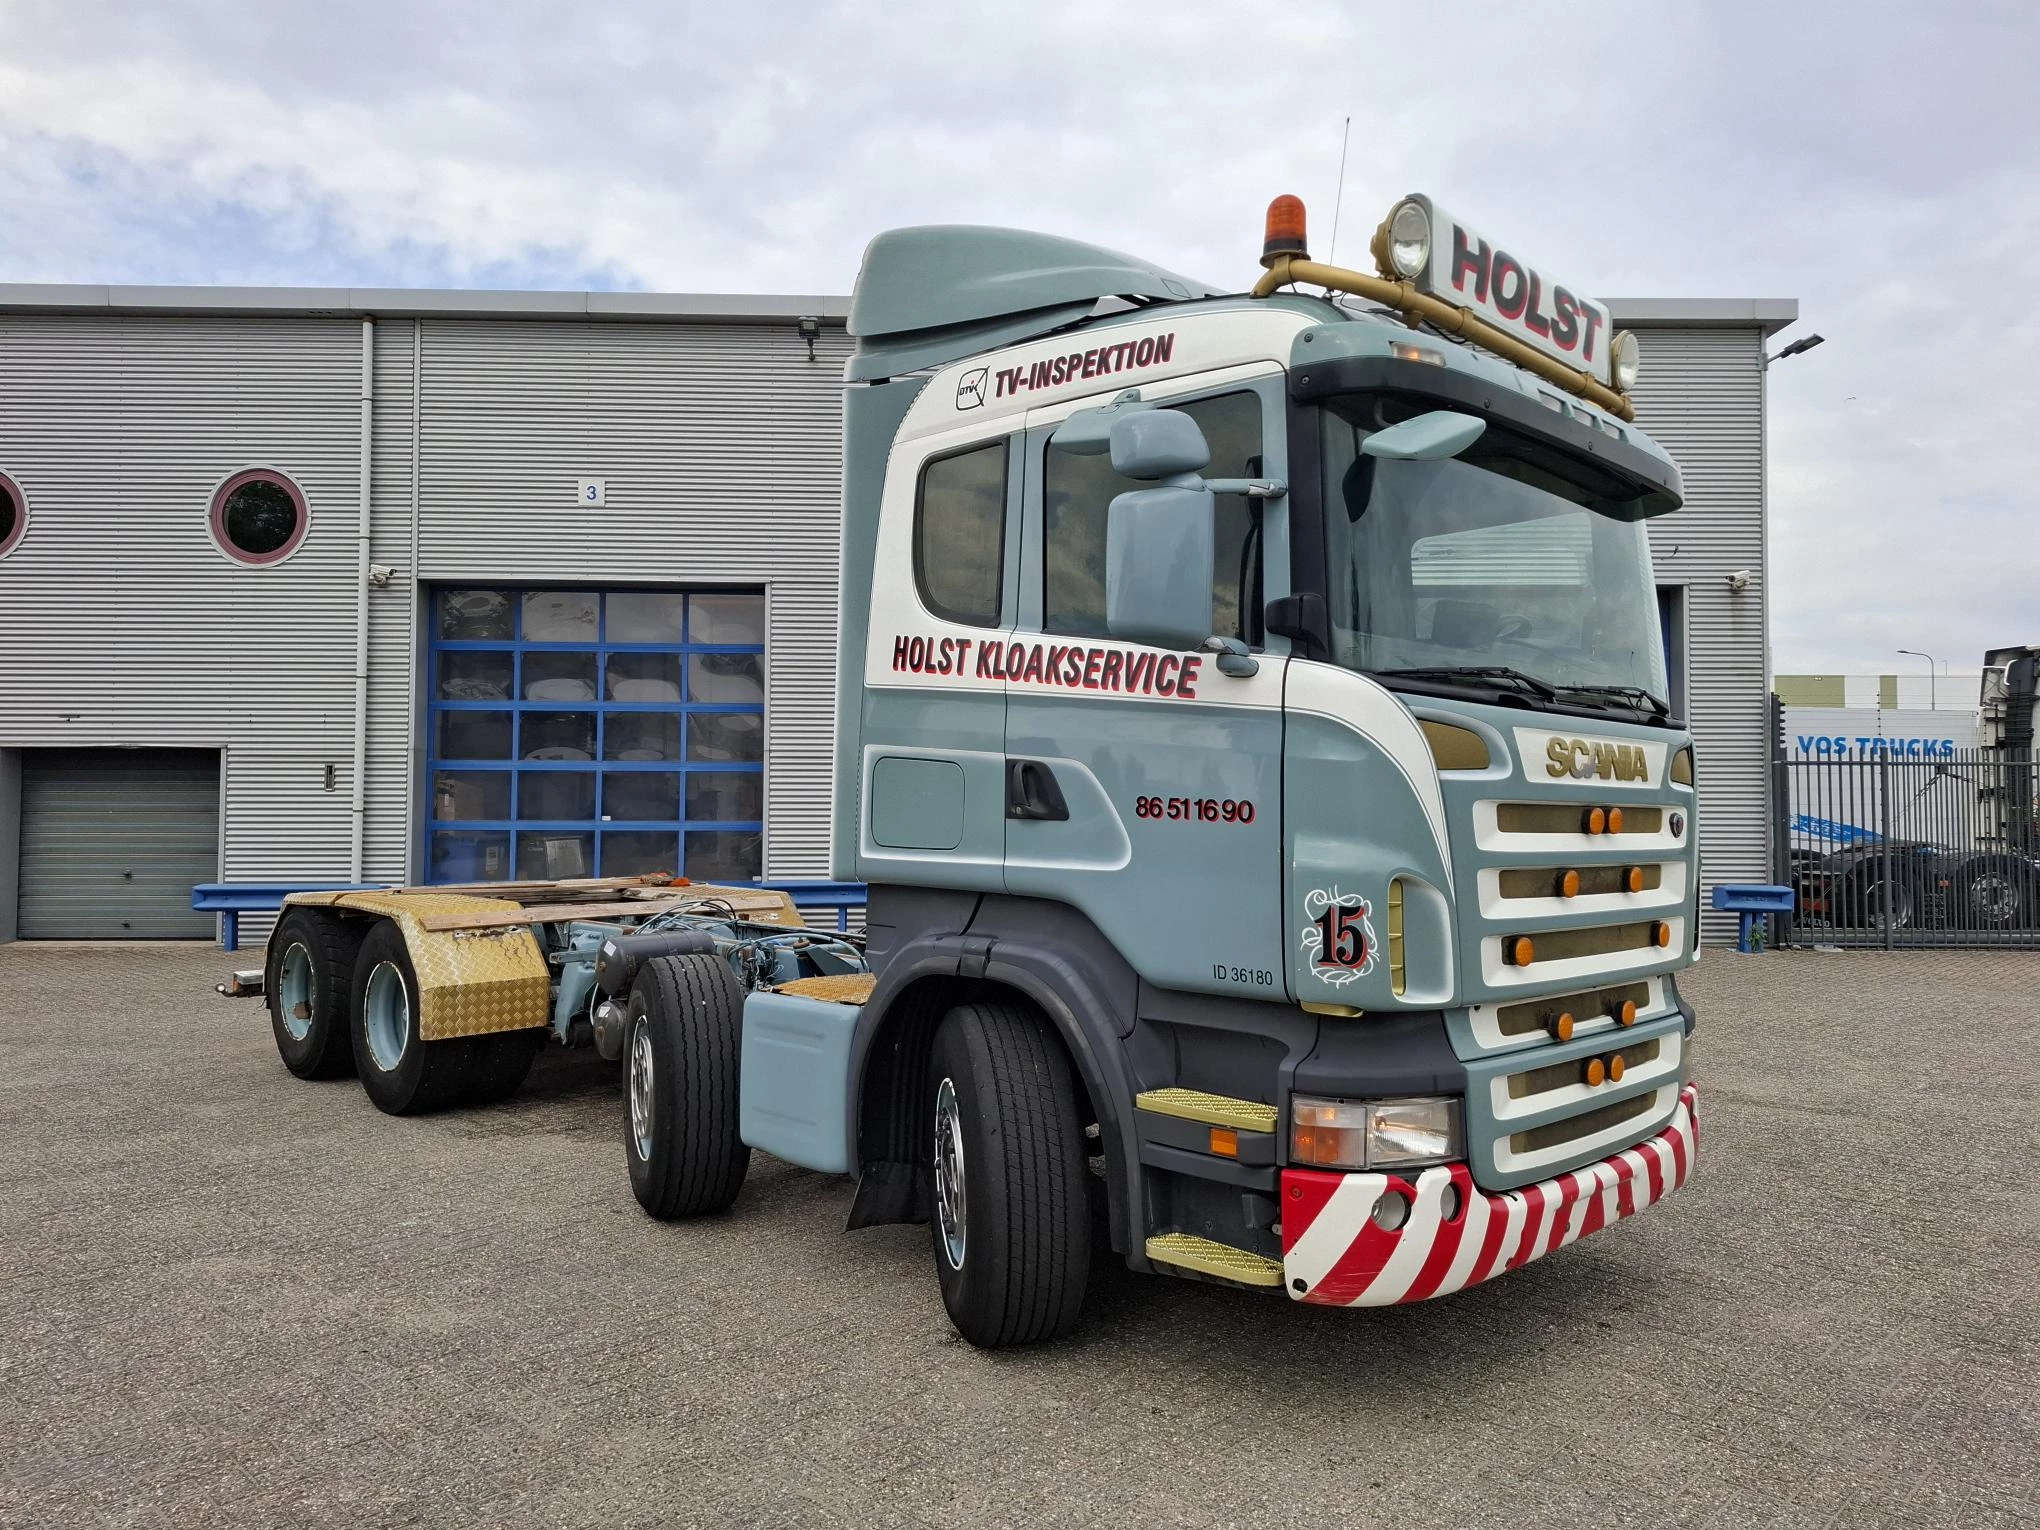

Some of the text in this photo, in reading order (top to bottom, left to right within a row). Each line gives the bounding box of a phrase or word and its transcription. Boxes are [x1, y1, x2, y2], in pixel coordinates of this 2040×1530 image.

[1451, 222, 1602, 362] HOLST
[995, 332, 1175, 398] TV-INSPEKTION
[586, 485, 597, 500] 3
[892, 635, 1202, 698] HOLST KLOAKSERVICE
[1546, 736, 1649, 782] SCANIA
[1797, 735, 1954, 758] VOS TRUCKS
[1314, 905, 1368, 969] 15
[1213, 963, 1273, 986] ID 36180
